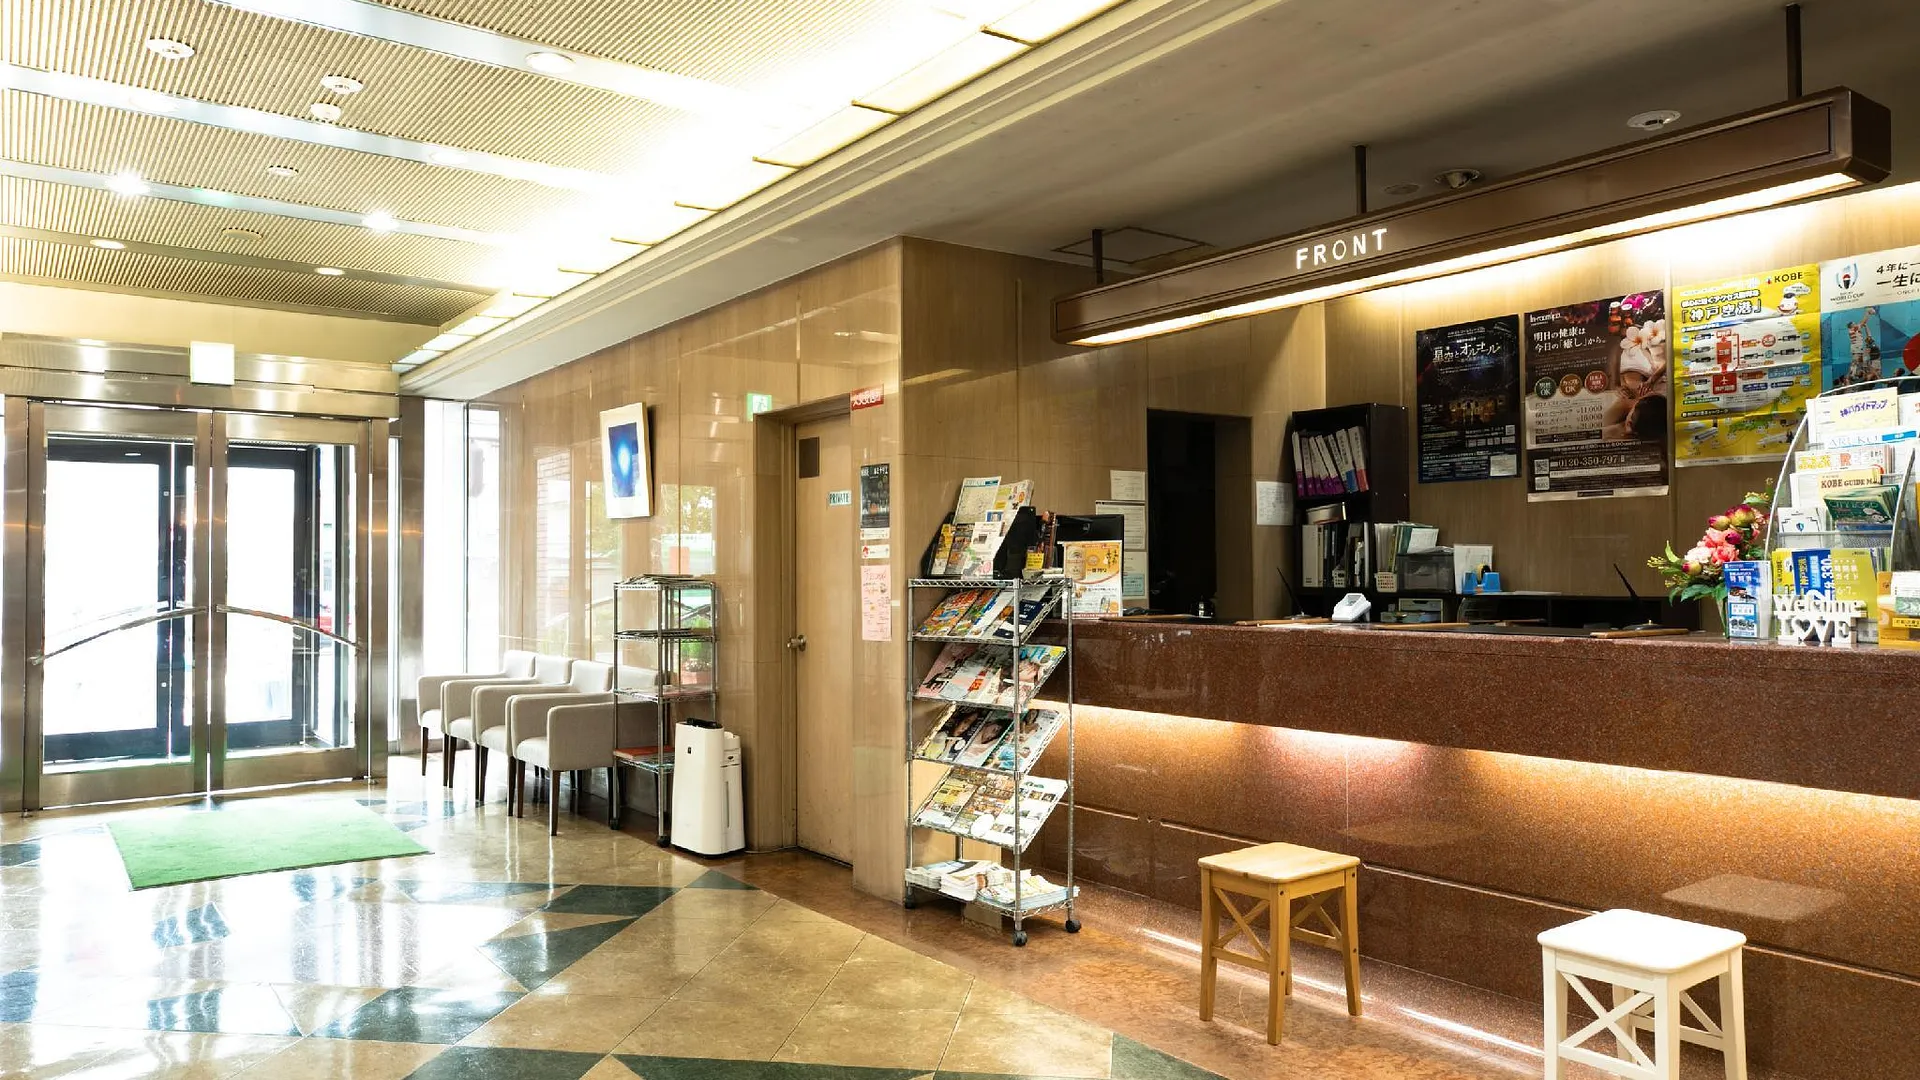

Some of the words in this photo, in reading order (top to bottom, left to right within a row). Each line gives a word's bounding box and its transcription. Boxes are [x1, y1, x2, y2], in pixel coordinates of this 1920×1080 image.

[1296, 228, 1388, 270] FRONT
[1774, 271, 1803, 283] KOBE
[1533, 326, 1586, 342] 明日の健康は
[1432, 341, 1501, 363] 星空とオルゴール
[1534, 336, 1606, 353] 今日の「癒し」から。
[1540, 388, 1551, 396] OK
[1821, 479, 1842, 489] KOBE
[1843, 479, 1866, 487] GUIDE
[829, 492, 849, 504] PRIVATE
[1773, 589, 1868, 613] Welcome
